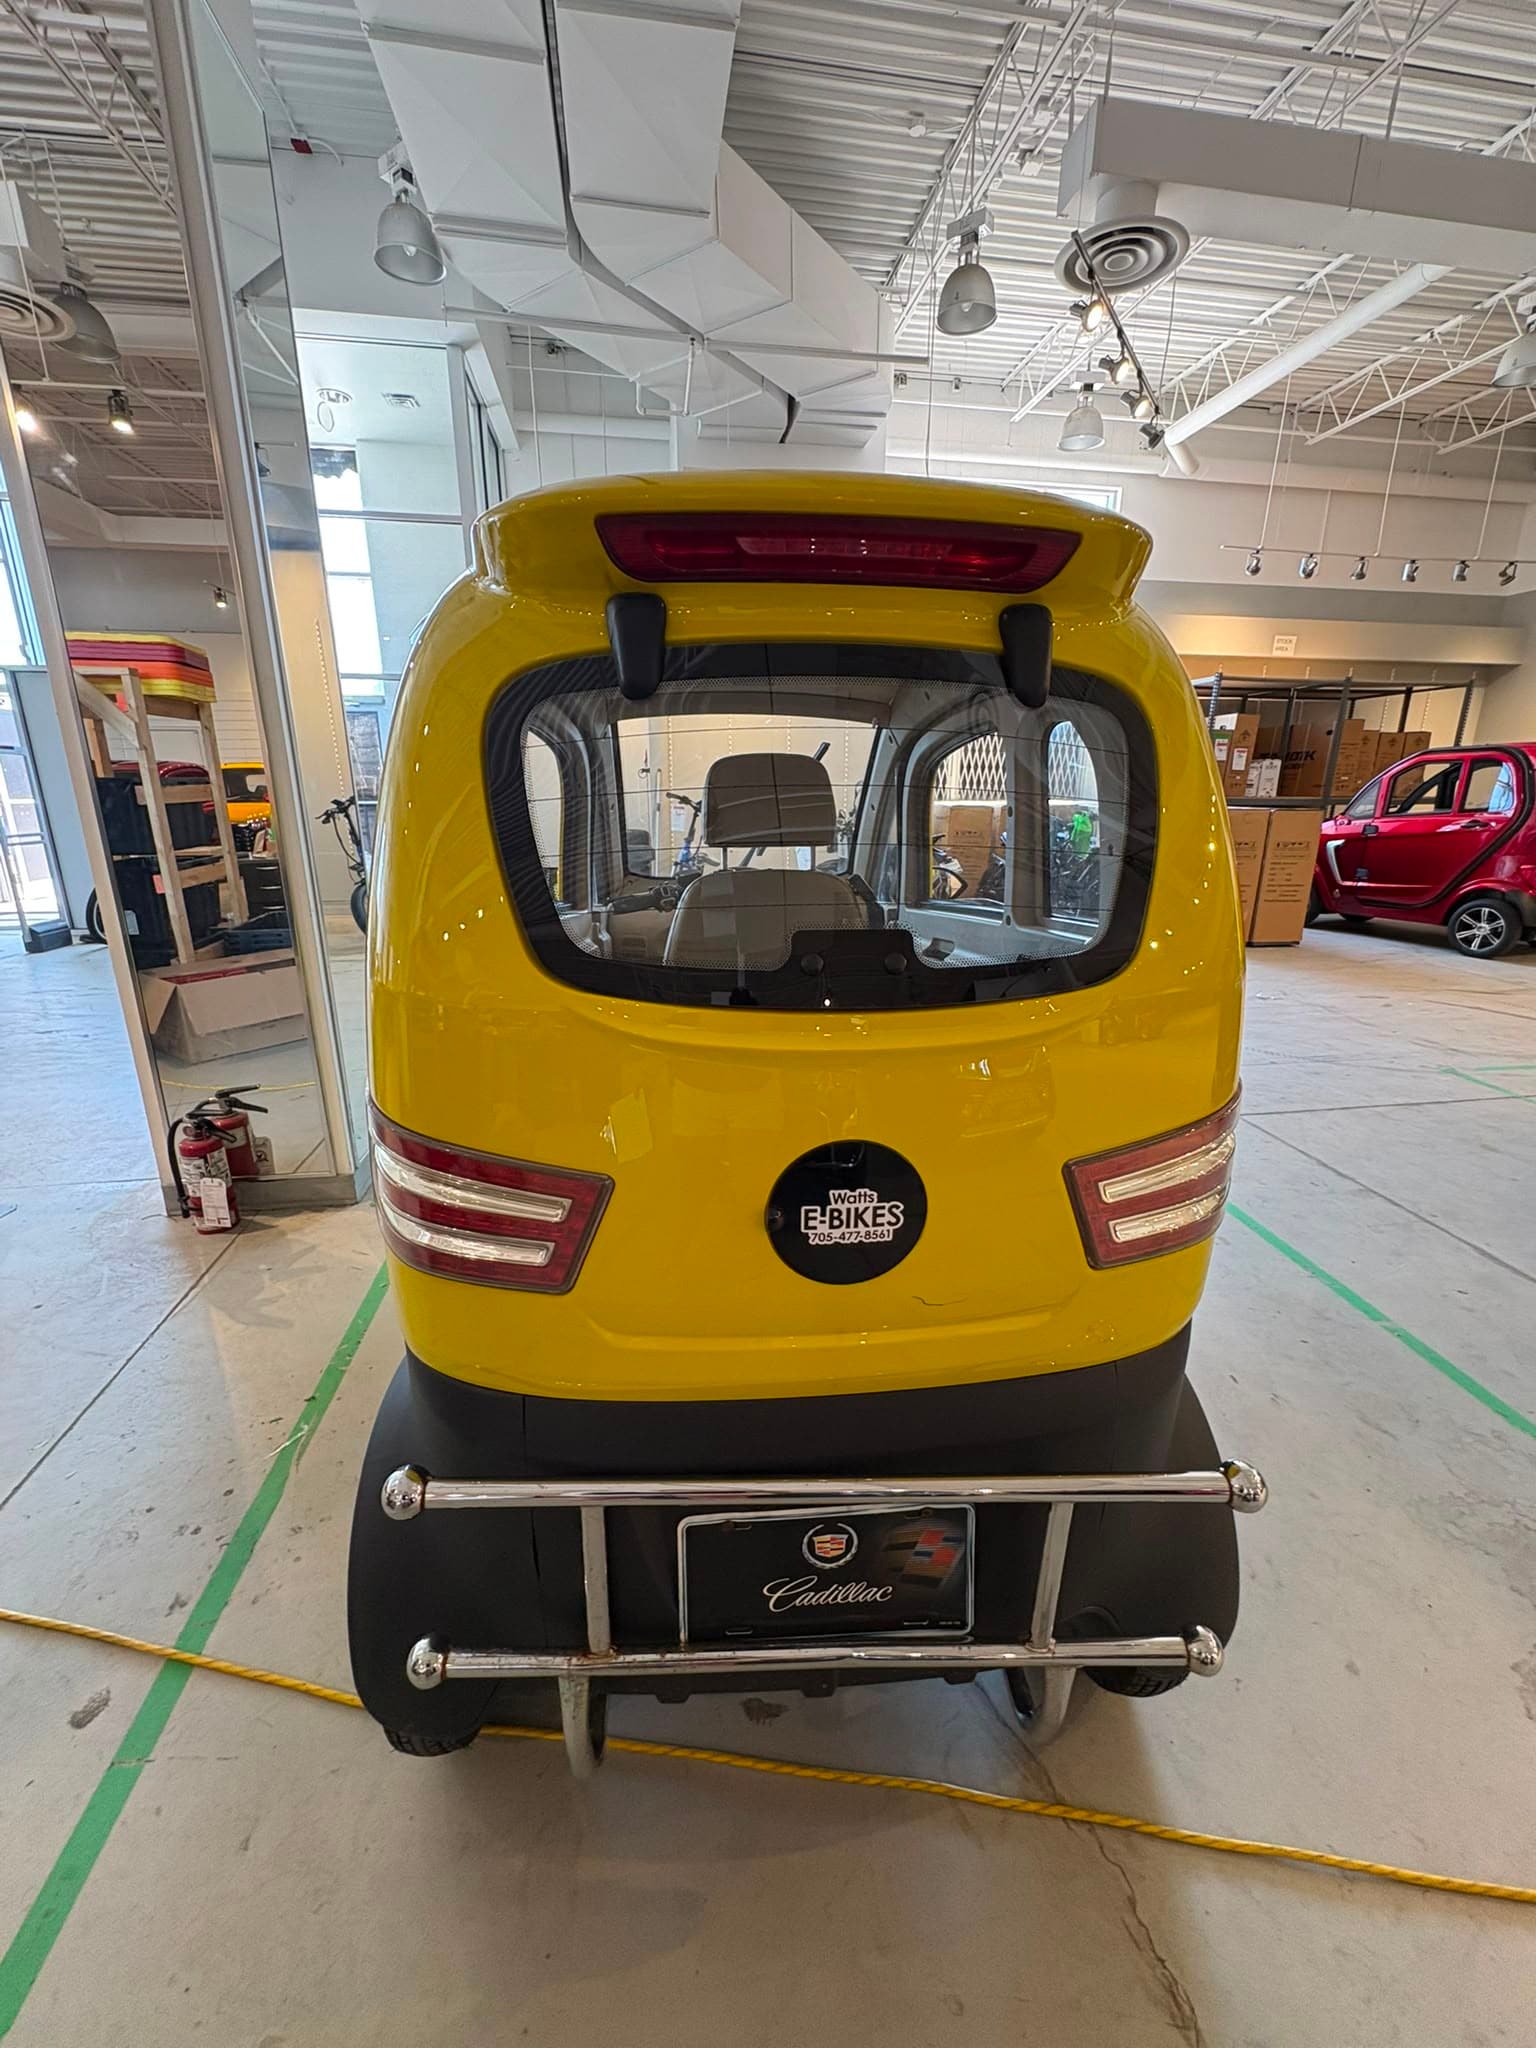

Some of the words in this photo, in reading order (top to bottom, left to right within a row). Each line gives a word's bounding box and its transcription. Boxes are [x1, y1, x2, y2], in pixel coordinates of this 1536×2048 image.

[830, 1190, 876, 1206] Watts
[802, 1203, 902, 1230] E-BIKES
[809, 1229, 891, 1242] 705-477-8561
[762, 1575, 894, 1613] Cadillac
